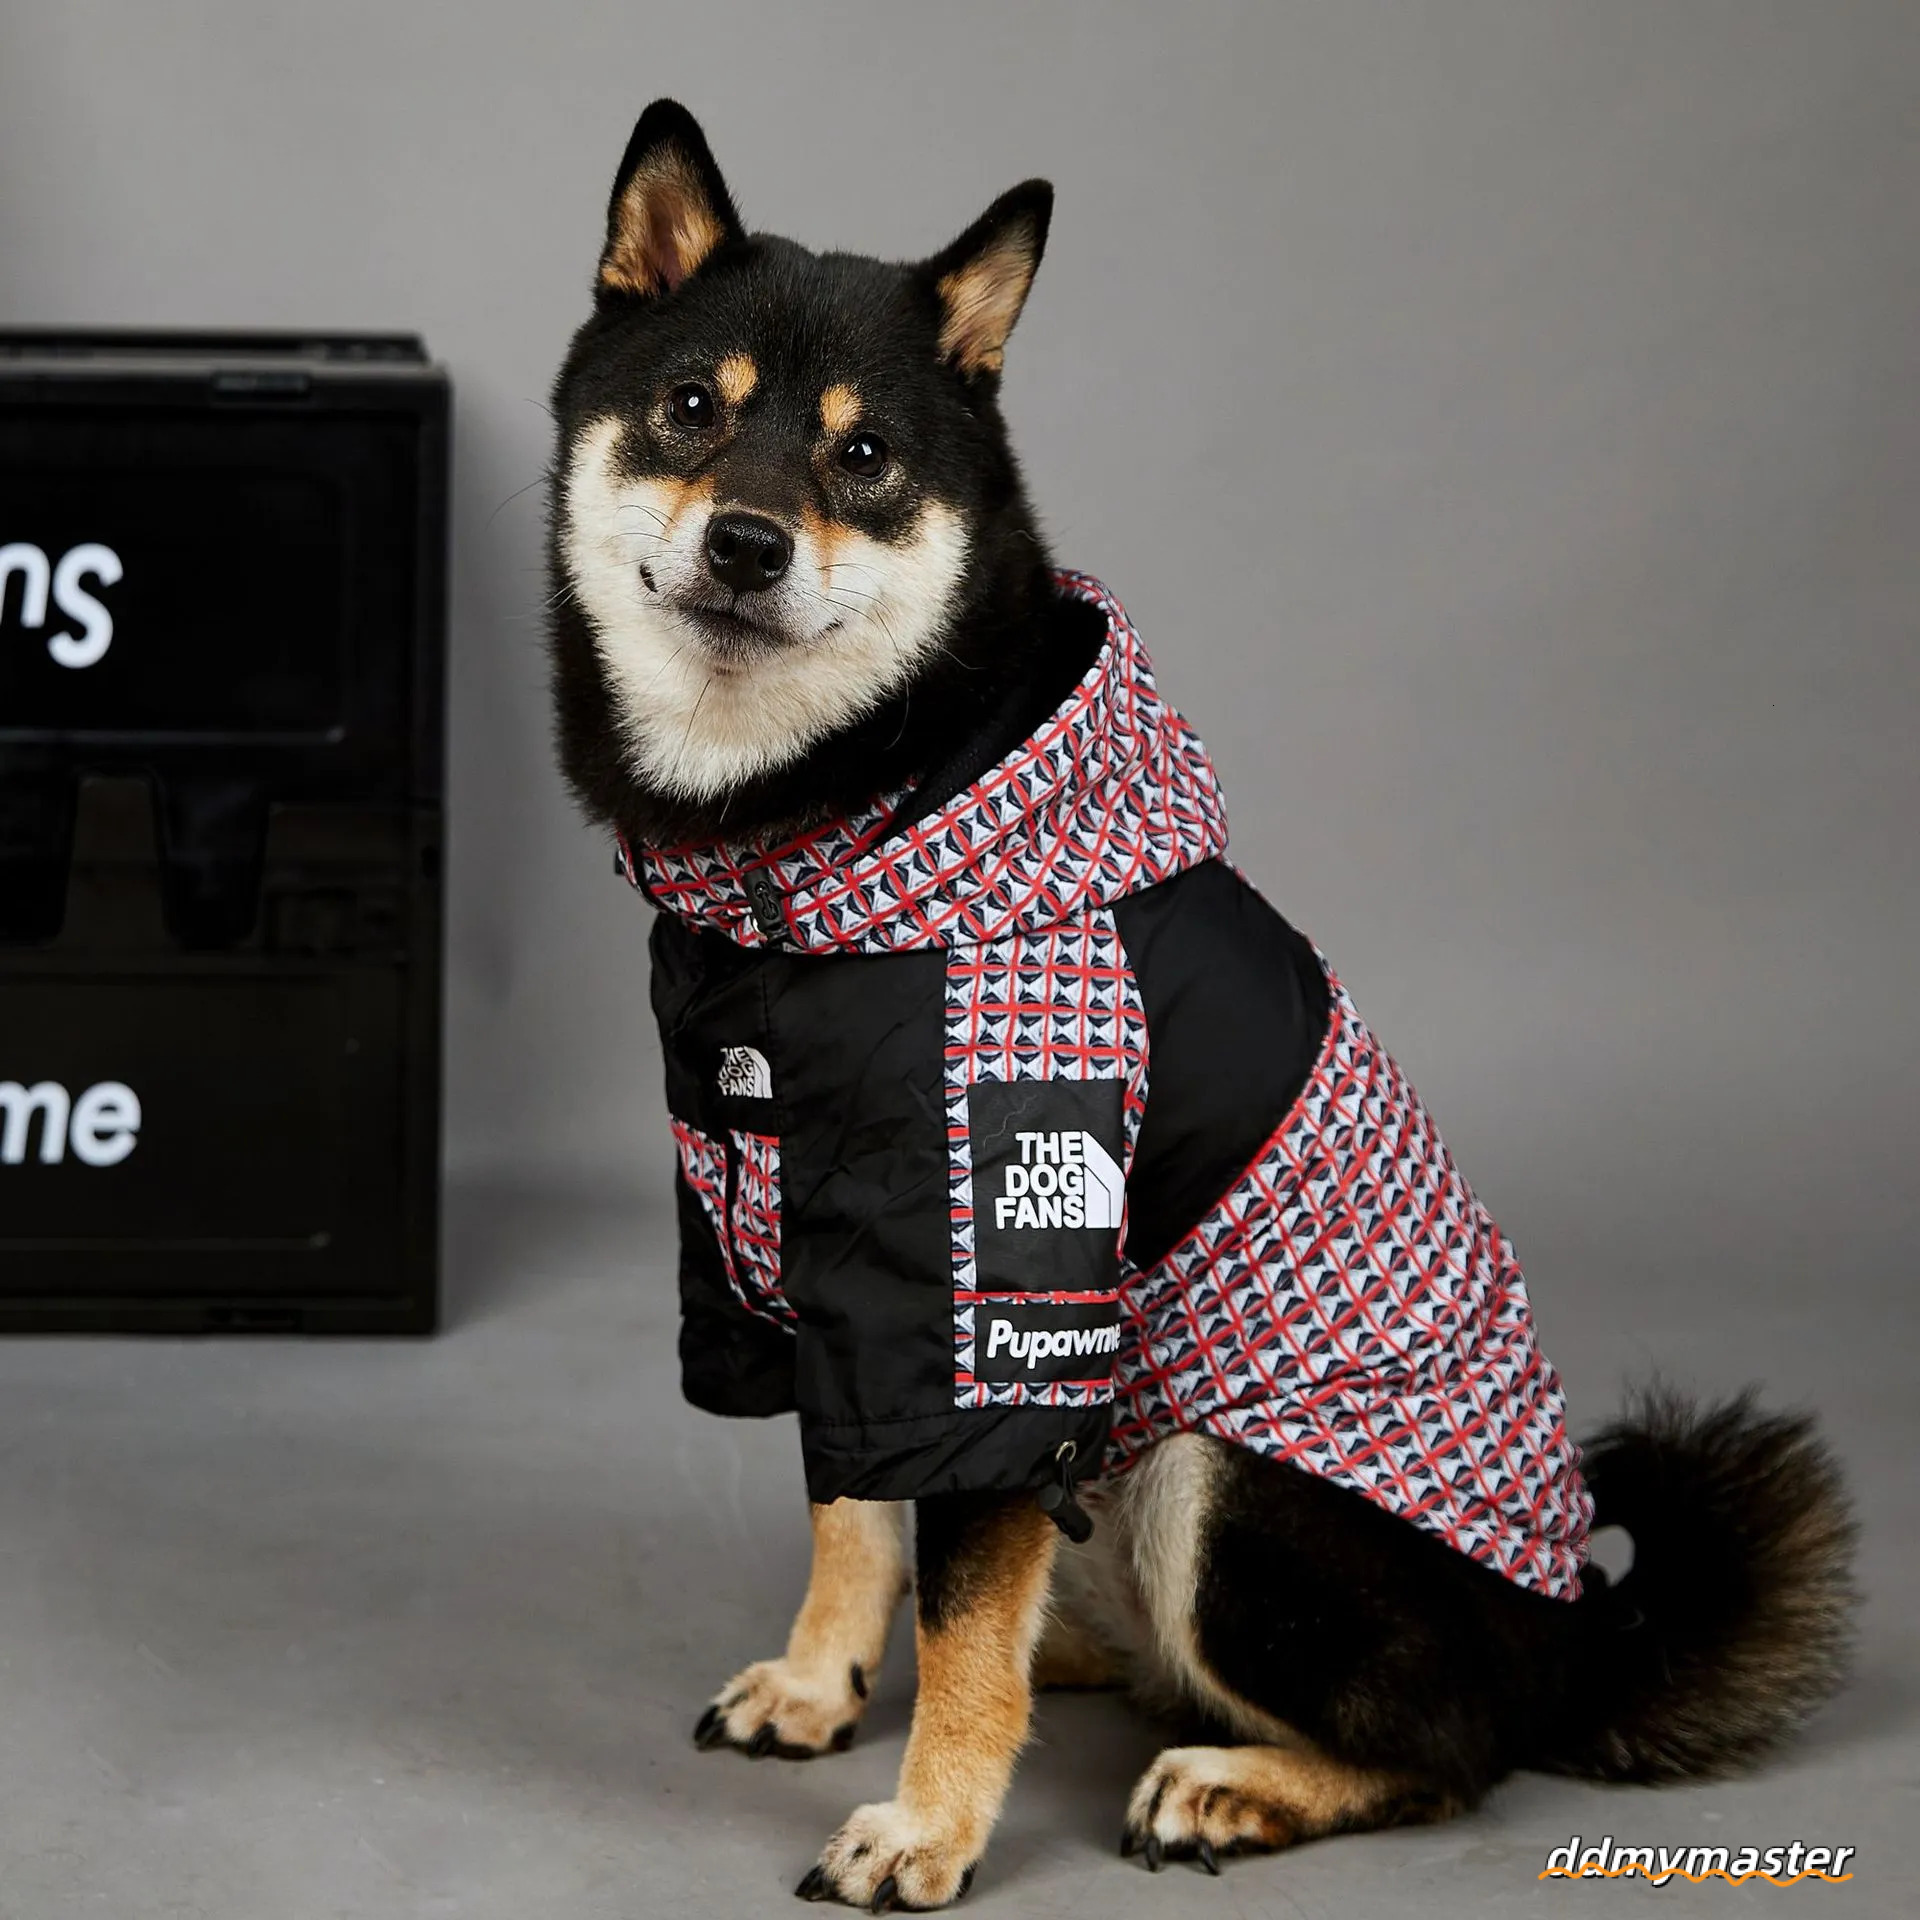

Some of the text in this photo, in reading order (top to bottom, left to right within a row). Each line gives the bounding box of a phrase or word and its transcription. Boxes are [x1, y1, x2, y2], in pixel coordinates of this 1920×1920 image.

[720, 1046, 750, 1065] THE
[718, 1060, 755, 1081] DOG
[717, 1077, 754, 1097] FANS
[1015, 1131, 1083, 1164] THE
[1005, 1164, 1084, 1197] DOG
[994, 1196, 1086, 1230] FANS
